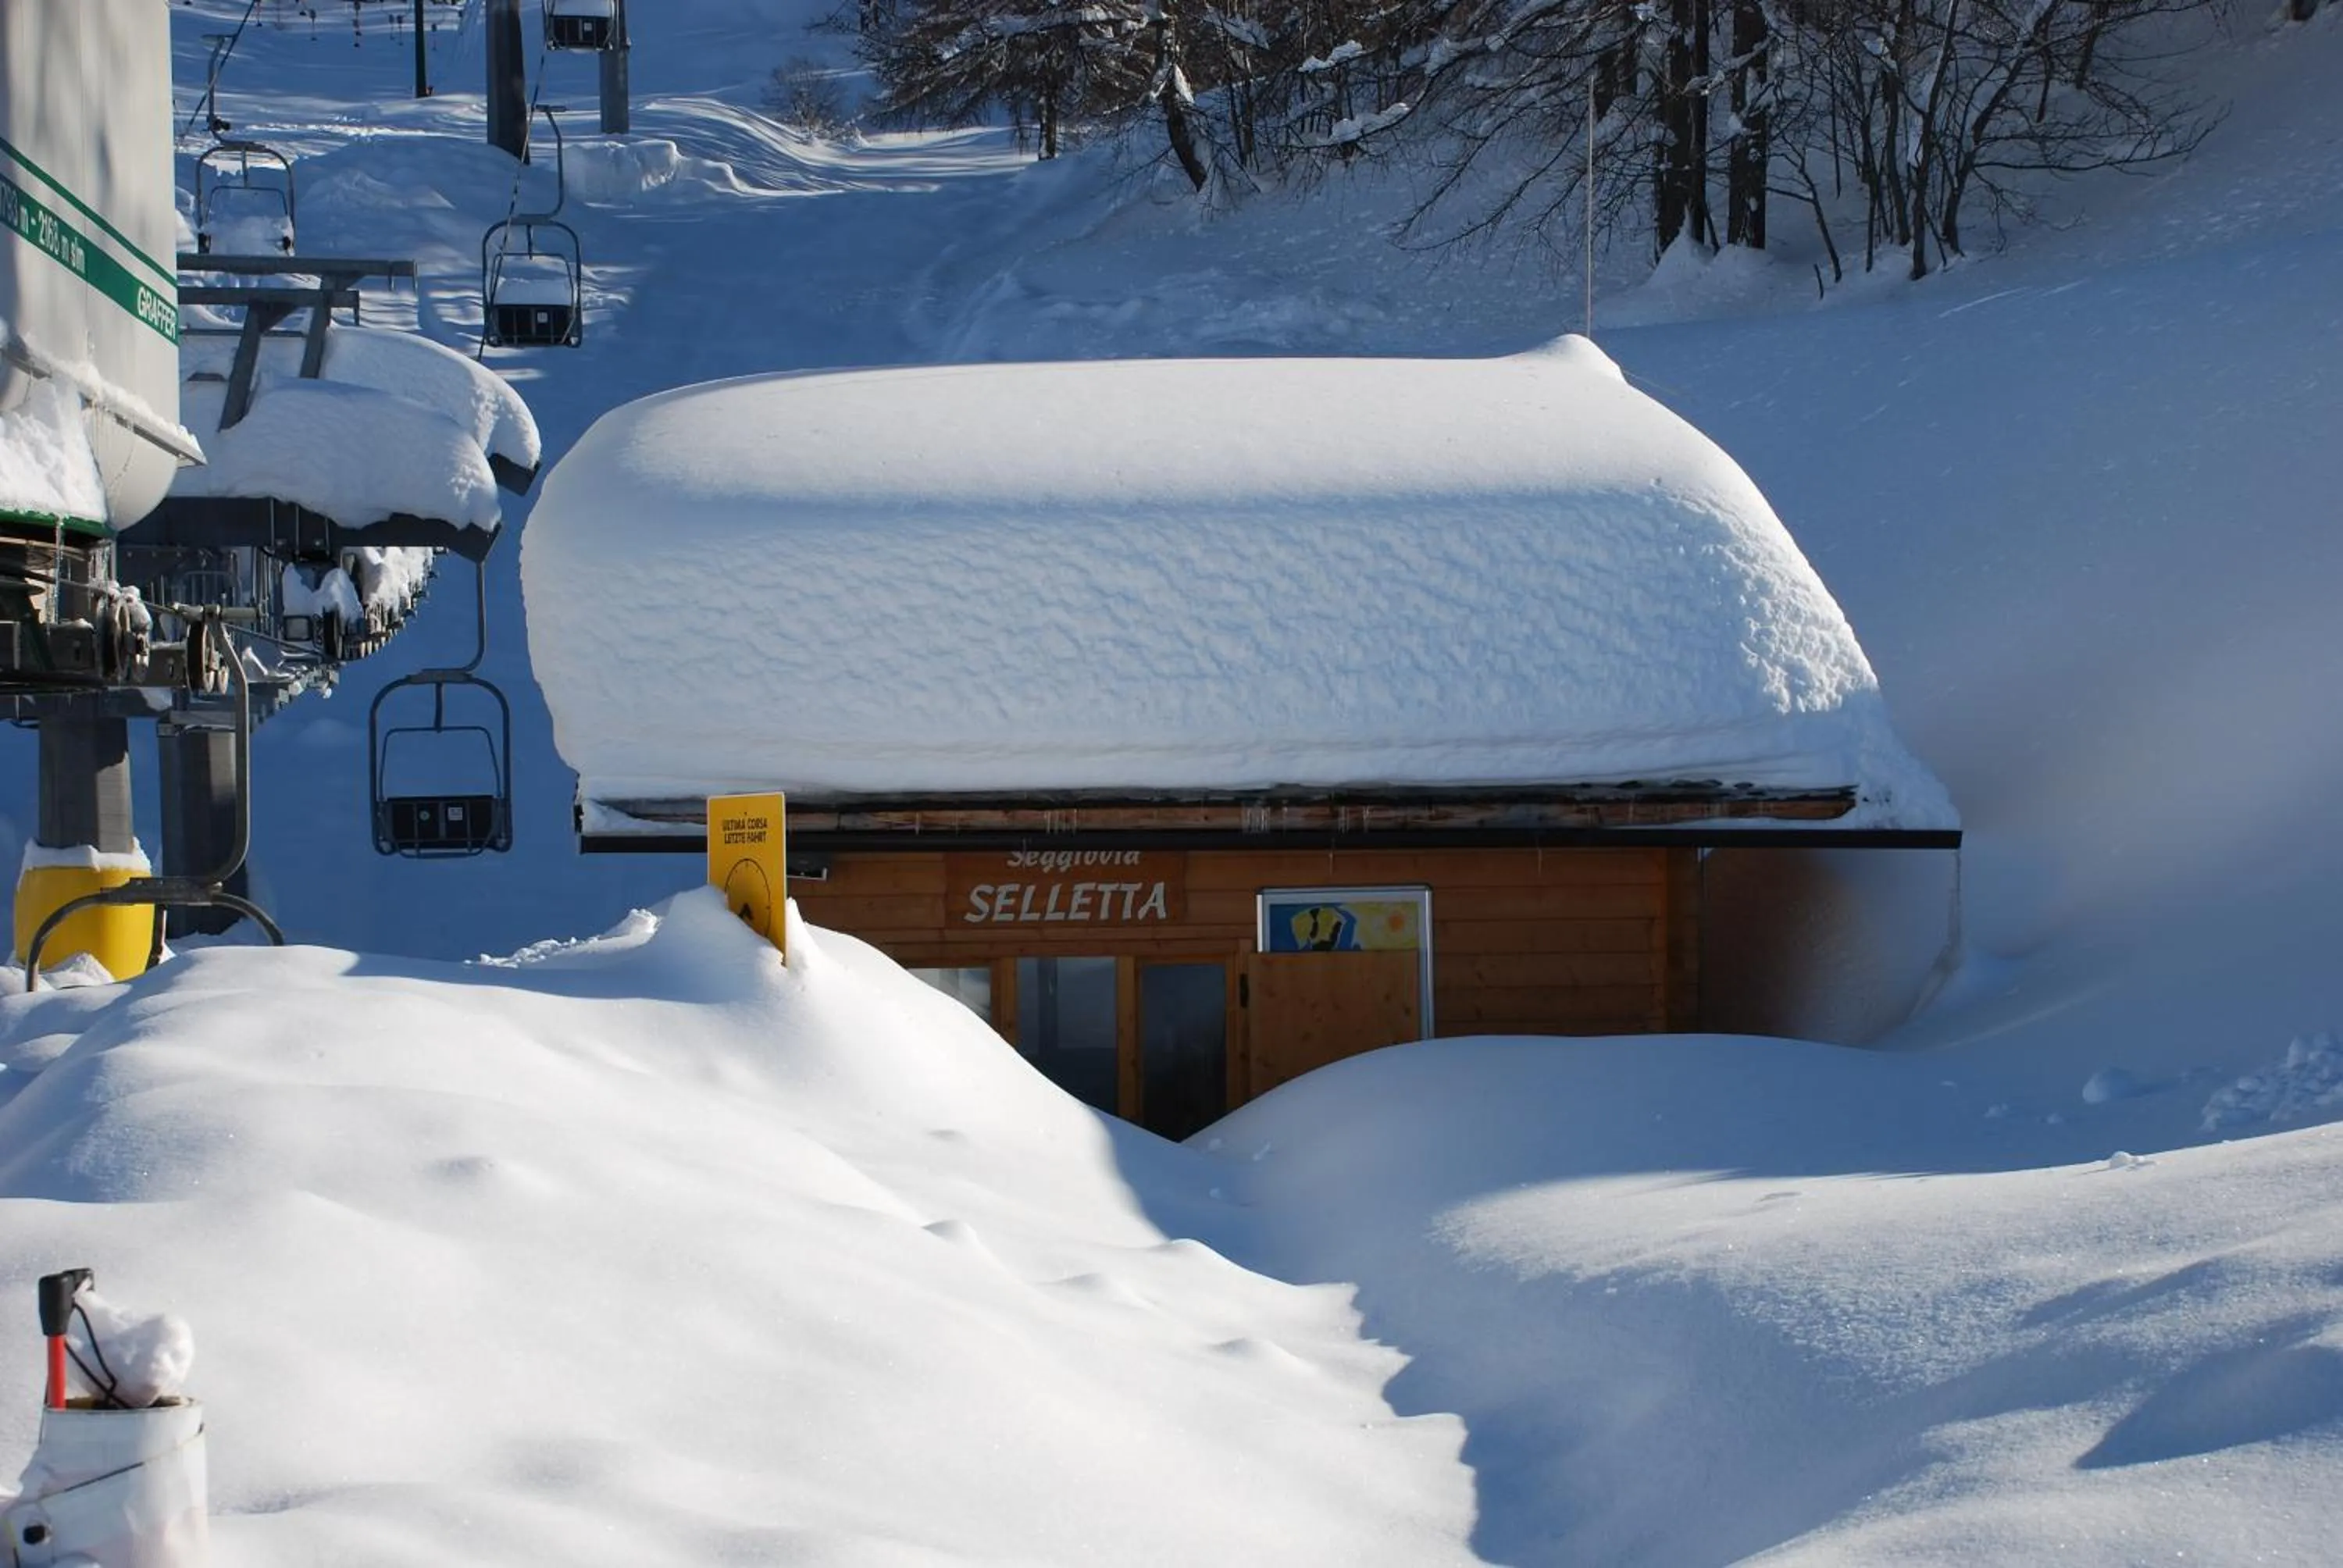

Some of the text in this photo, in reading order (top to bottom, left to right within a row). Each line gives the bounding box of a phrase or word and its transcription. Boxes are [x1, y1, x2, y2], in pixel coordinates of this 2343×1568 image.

[137, 287, 176, 340] GRAFFER
[722, 817, 768, 832] ULTIMA CORSA
[1007, 850, 1140, 873] Seggiovia
[963, 881, 1167, 923] SELLETTA
